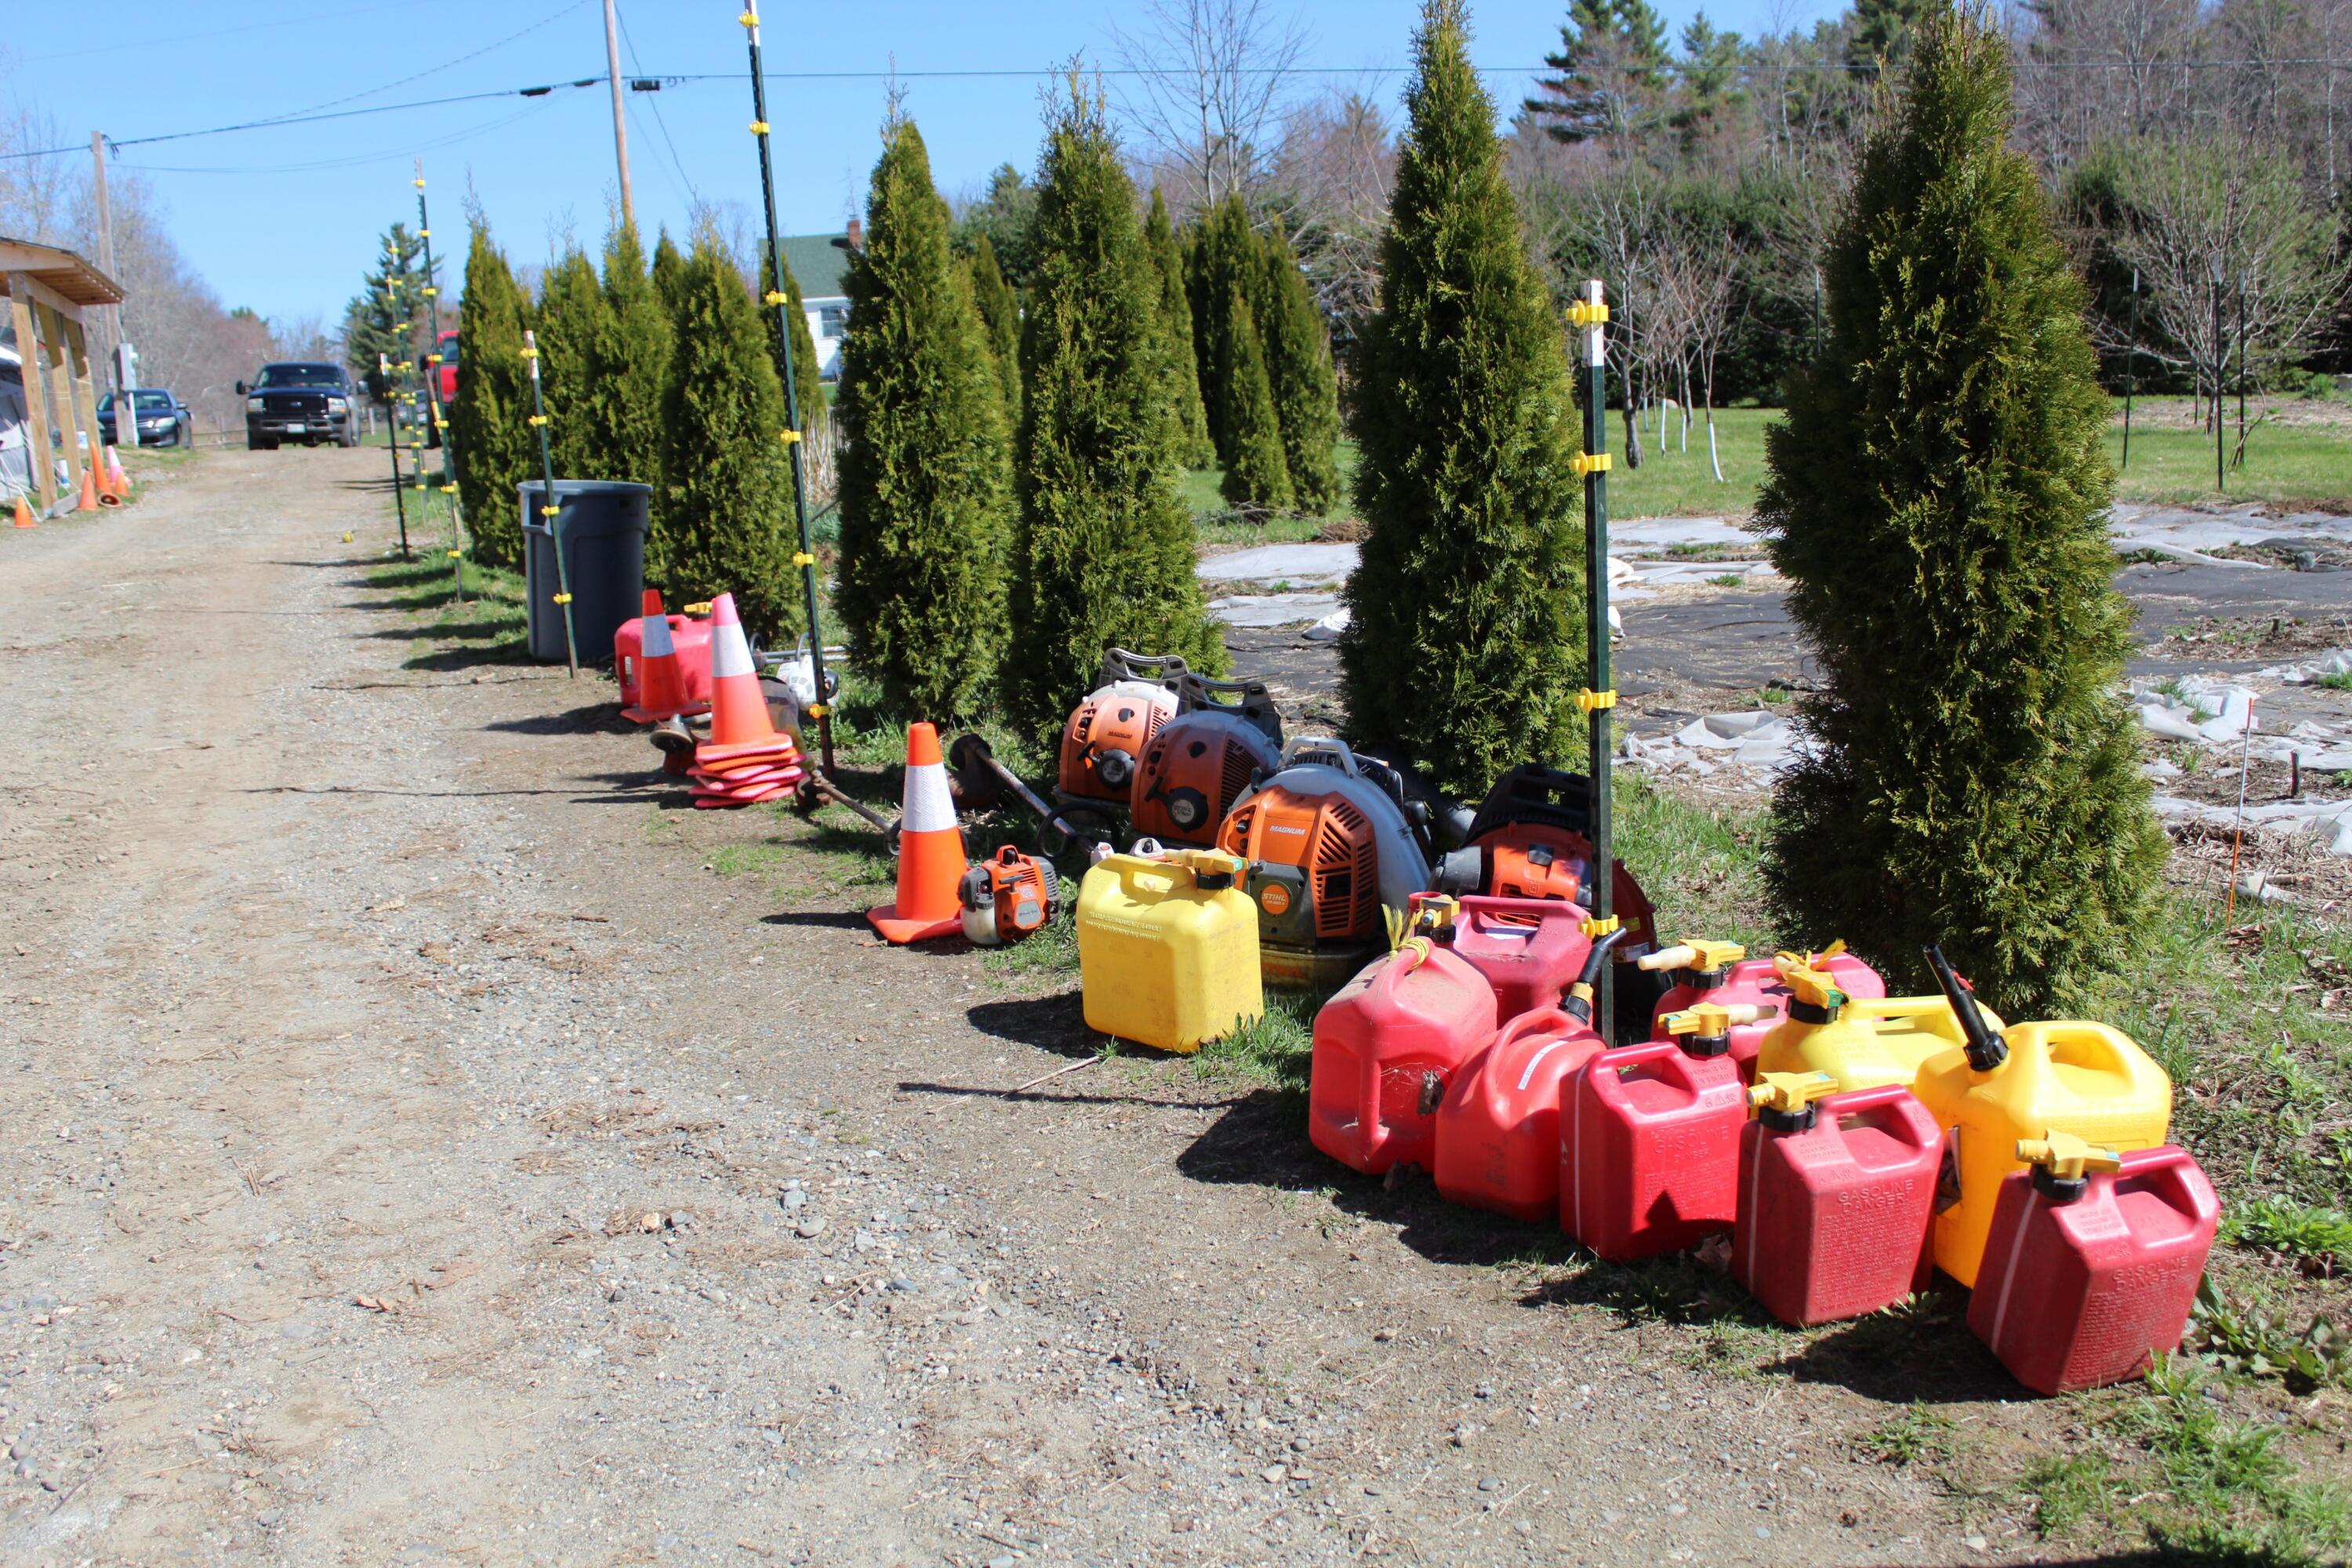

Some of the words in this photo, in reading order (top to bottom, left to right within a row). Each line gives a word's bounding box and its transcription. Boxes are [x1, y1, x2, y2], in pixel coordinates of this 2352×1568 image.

[1269, 825, 1305, 836] MAGNUM
[1262, 892, 1286, 902] STIHL
[1654, 1125, 1729, 1154] GASOLINE
[1838, 1179, 1913, 1203] GASOLINE
[2112, 1256, 2189, 1280] GASOLINE
